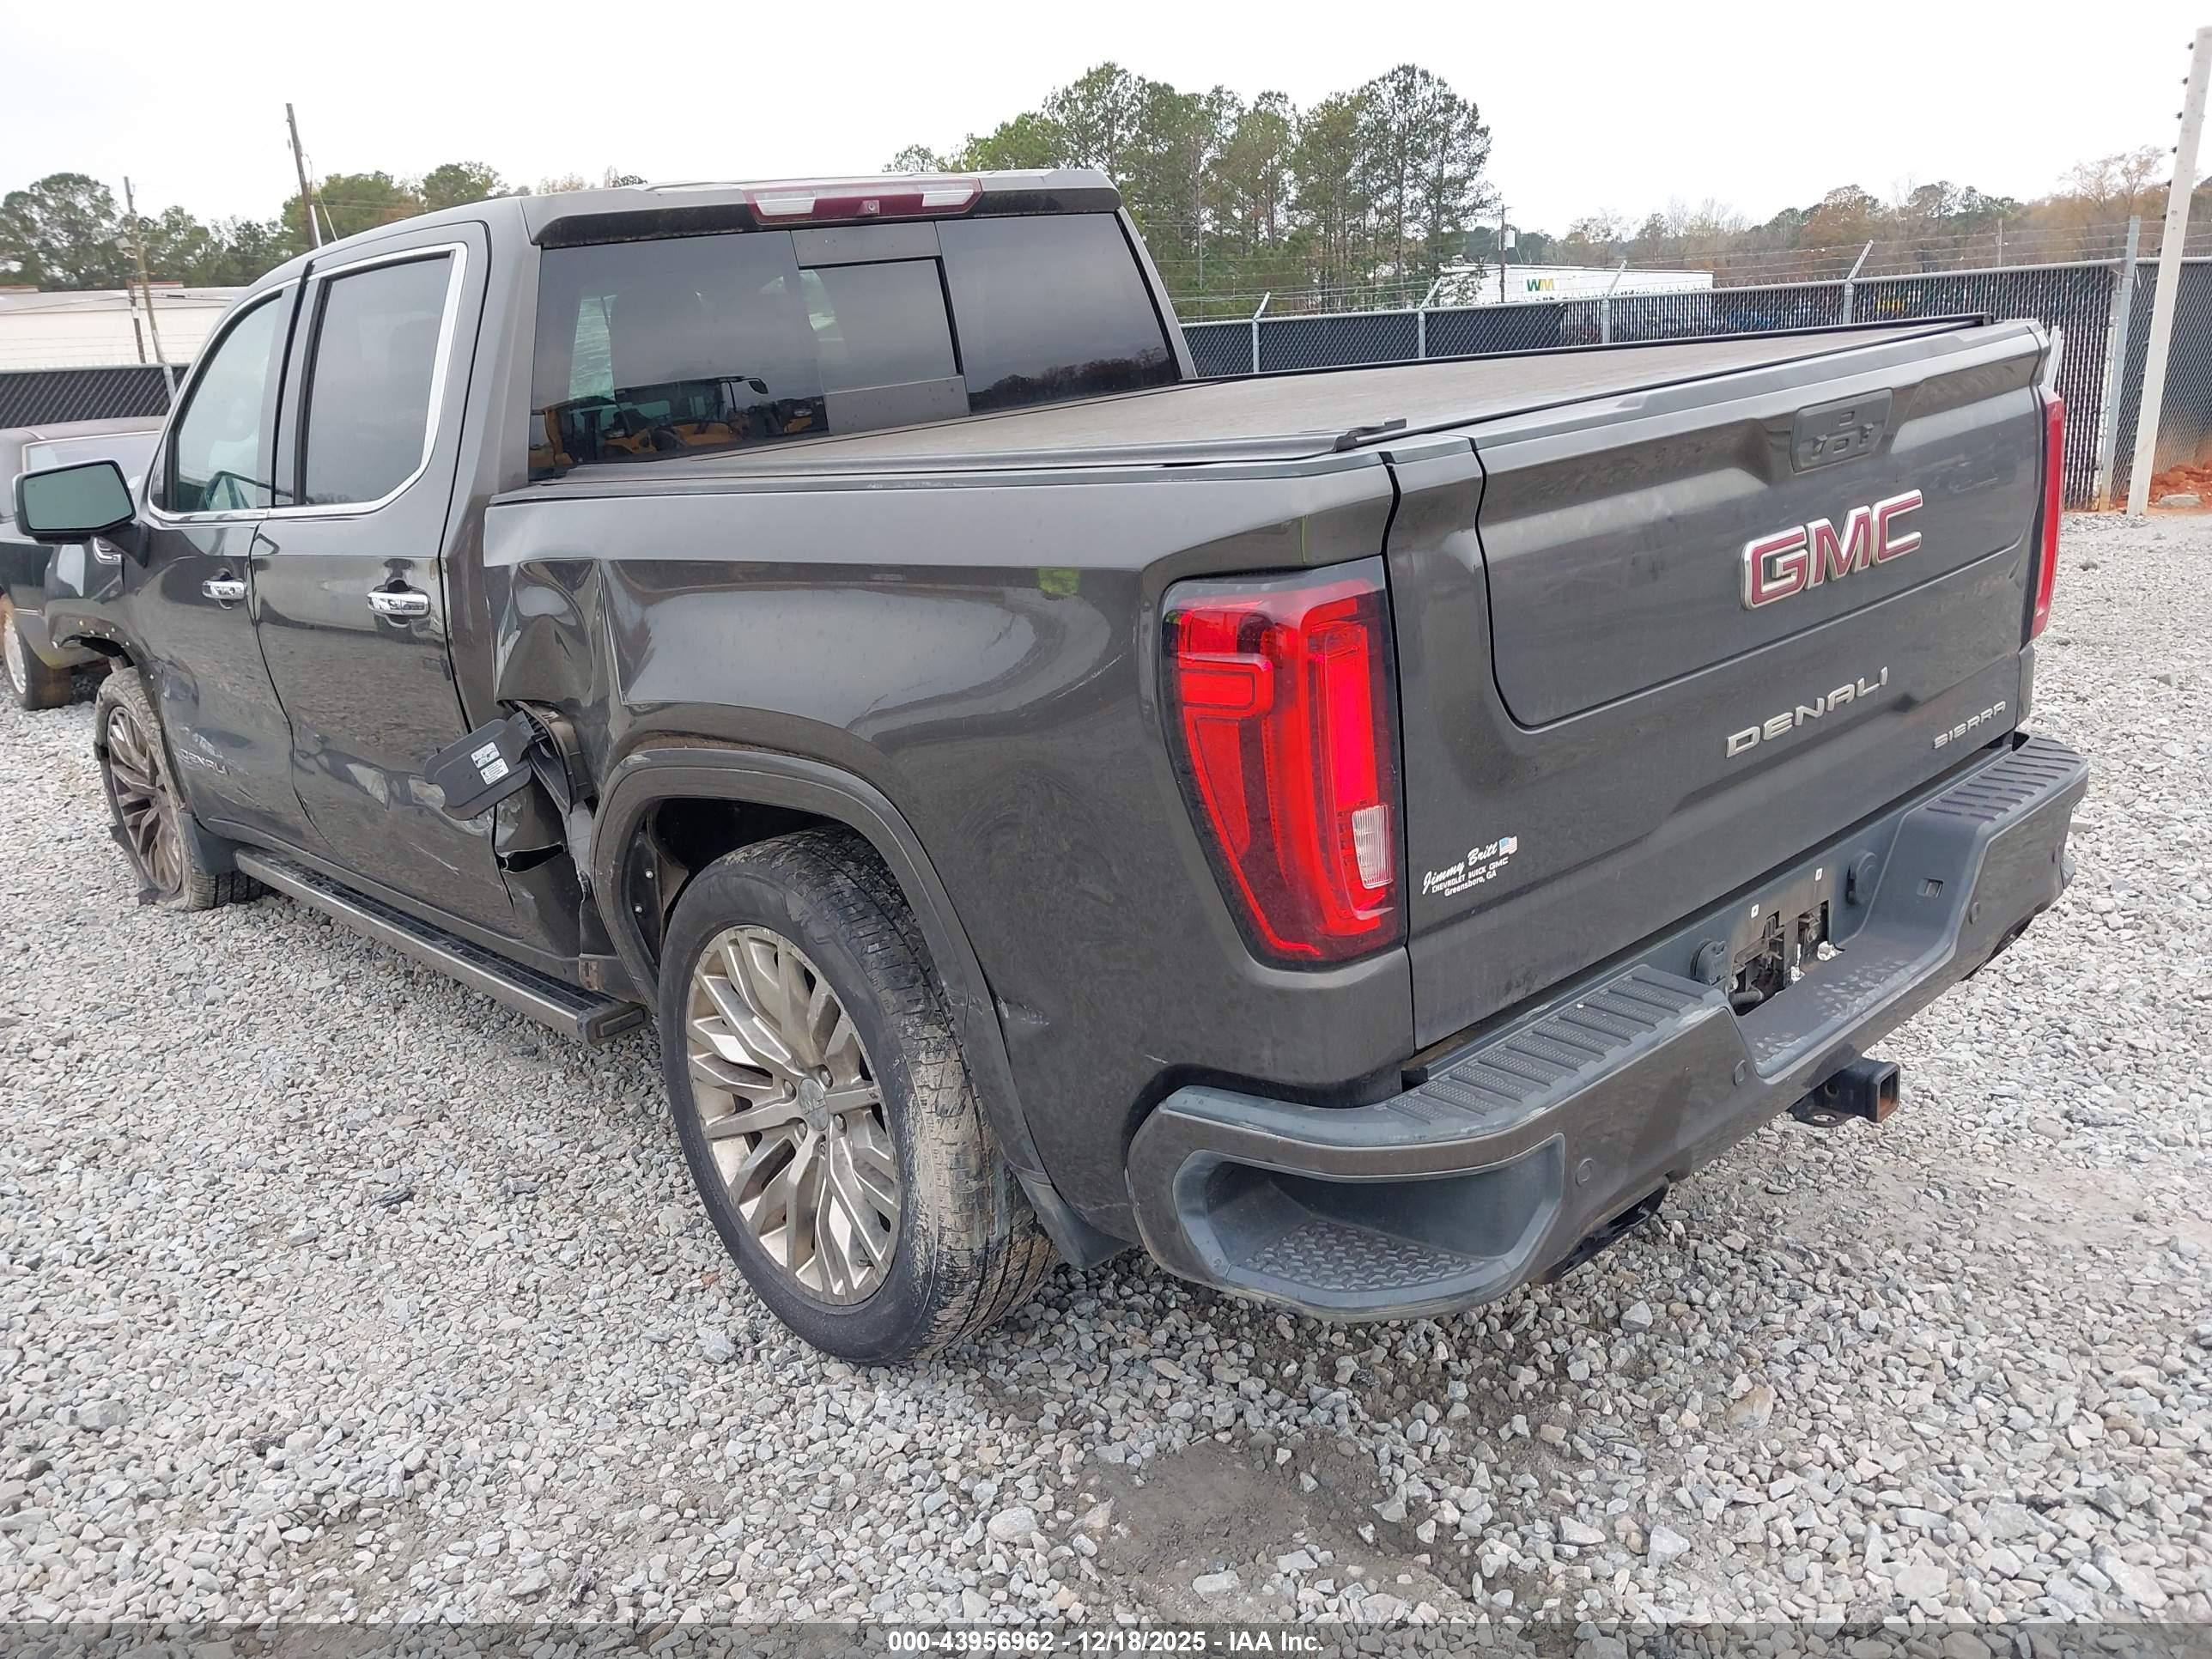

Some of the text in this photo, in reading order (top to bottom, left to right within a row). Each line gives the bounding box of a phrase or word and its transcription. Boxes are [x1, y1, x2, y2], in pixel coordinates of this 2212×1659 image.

[1527, 278, 1554, 292] WM
[1740, 489, 1923, 611] GMC
[1725, 666, 1888, 759] DENALI
[1933, 701, 2007, 750] SIERRA
[1422, 842, 1498, 895] Jimmy Britt
[1431, 857, 1509, 894] CHEVROLET BUICK GMC
[1444, 869, 1497, 896] Greensboro, GA
